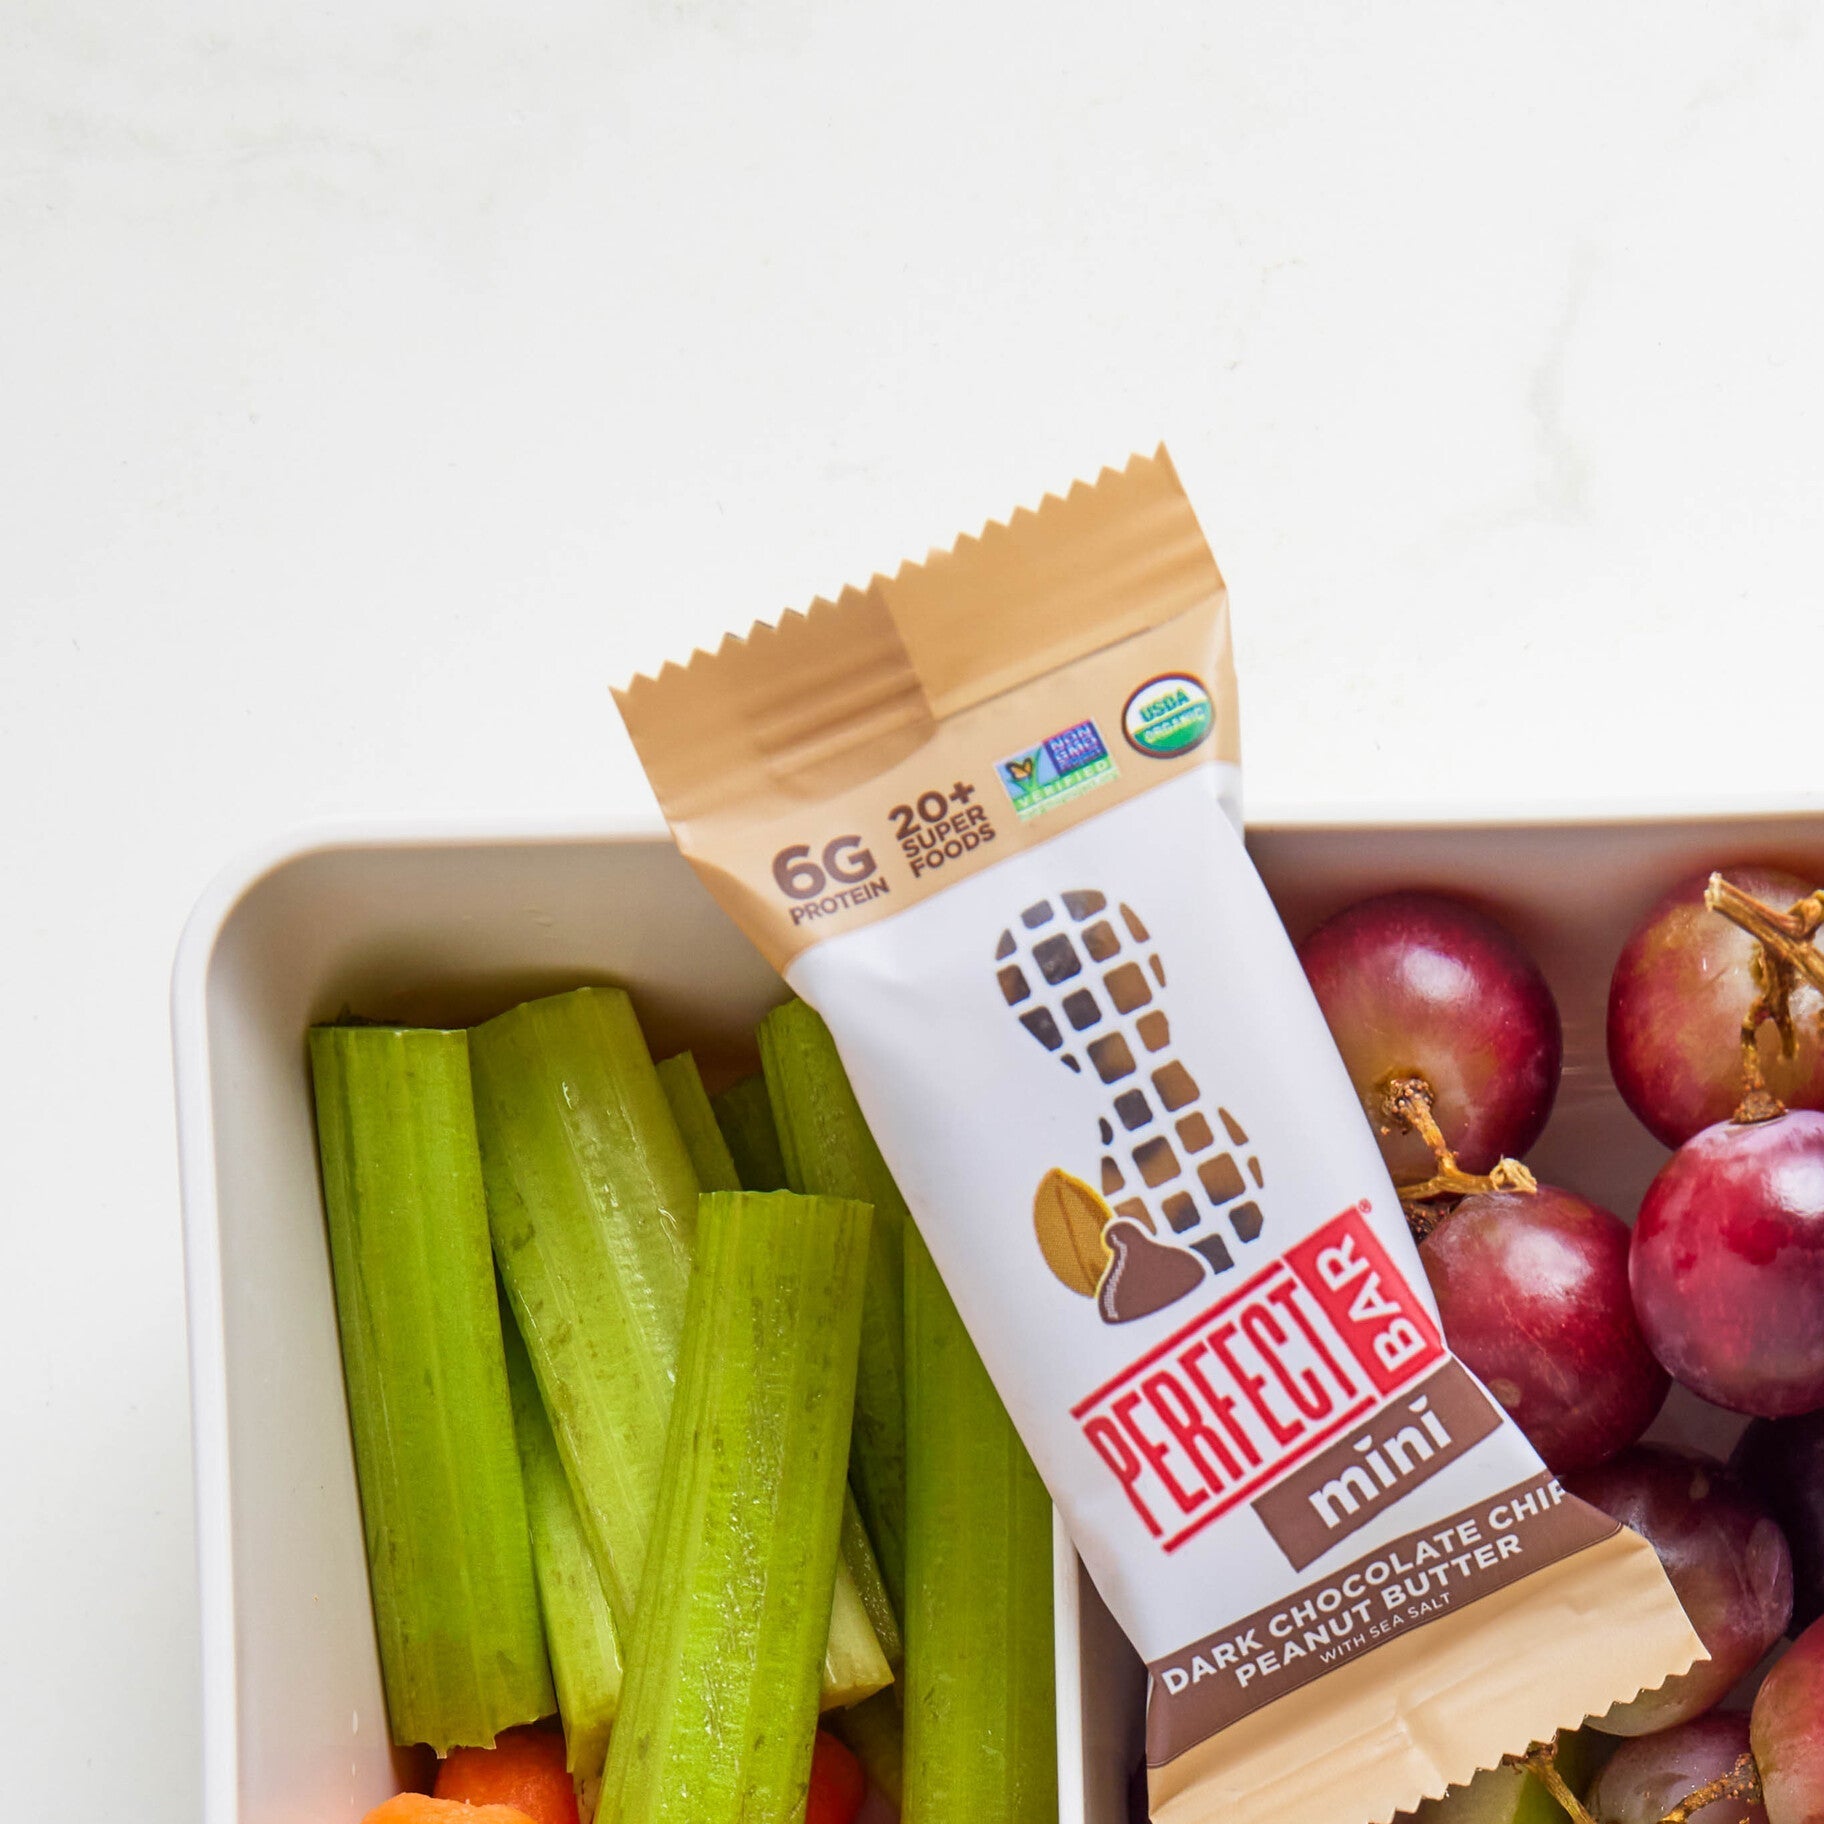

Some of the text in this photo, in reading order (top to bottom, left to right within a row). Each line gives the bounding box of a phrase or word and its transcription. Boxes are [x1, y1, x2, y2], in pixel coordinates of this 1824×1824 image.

[1139, 688, 1190, 722] USDA
[888, 781, 976, 841] 20+
[901, 805, 988, 858] SUPER
[772, 834, 878, 900] 6G
[909, 823, 996, 878] FOODS
[789, 876, 890, 926] PROTEIN
[1082, 1234, 1428, 1539] PERFECT BAR
[1308, 1395, 1452, 1529] mini
[1161, 1629, 1263, 1695] DARK
[1268, 1519, 1482, 1638] CHOCOLATE
[1235, 1534, 1522, 1688] PEANUT BUTTER
[1319, 1592, 1451, 1664] WITH SEA SALT
